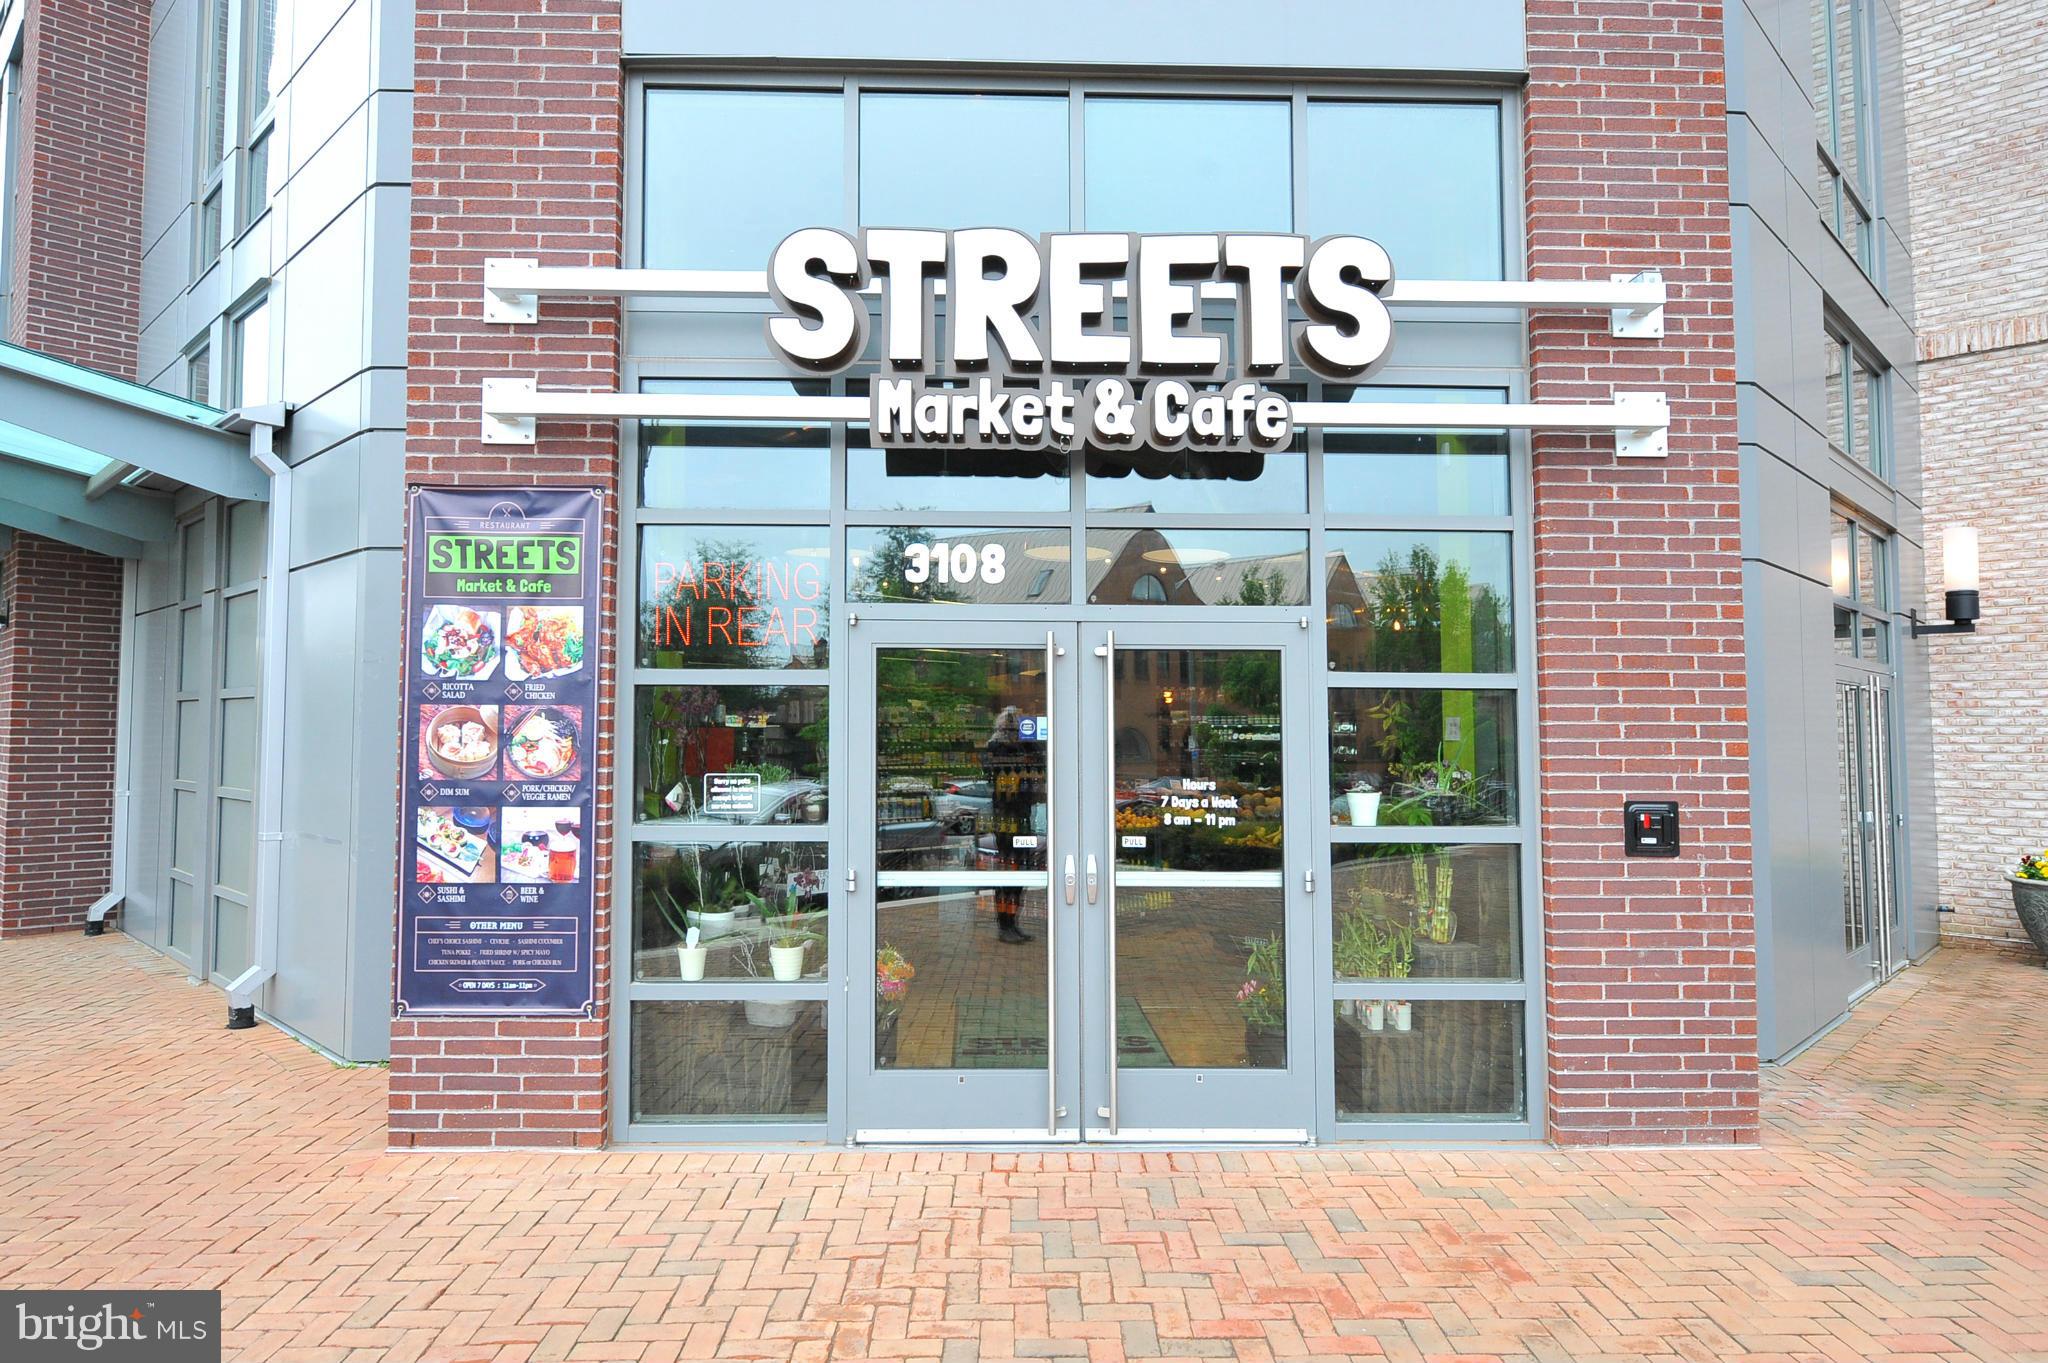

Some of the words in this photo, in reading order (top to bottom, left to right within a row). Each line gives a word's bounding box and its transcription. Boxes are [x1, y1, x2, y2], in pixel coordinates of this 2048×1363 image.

[769, 229, 1395, 369] STREETS
[878, 376, 1075, 446] Market
[1095, 378, 1136, 440] &
[1155, 378, 1289, 446] Cafe
[479, 522, 531, 530] RESTAURANT
[432, 539, 576, 570] STREETS
[904, 543, 1006, 584] 3108
[655, 561, 821, 600] PARKING
[456, 579, 502, 593] Market
[506, 580, 516, 593] &
[519, 580, 552, 593] Cafe
[655, 606, 691, 645] IN
[708, 606, 819, 645] REAR
[442, 683, 474, 691] RICOTTA
[525, 683, 545, 691] FRIED
[442, 691, 466, 699] SALAD
[525, 691, 555, 699] CHICKEN
[522, 785, 576, 793] PORK/CHICKEN/
[1182, 778, 1216, 792] Hours
[440, 788, 454, 796] DIM
[456, 788, 469, 796] SUM
[522, 792, 546, 800] VEGGIE
[548, 792, 570, 800] RAMEN
[1161, 797, 1168, 808] 7
[1171, 796, 1198, 811] Days
[1201, 799, 1209, 808] a
[1211, 796, 1238, 809] Week
[1164, 814, 1172, 826] 8
[1174, 817, 1192, 826] am
[1204, 814, 1216, 826] 11
[1219, 816, 1236, 828] pm
[438, 895, 466, 903] SASHIMI
[520, 895, 539, 903] WINE
[470, 922, 496, 930] OTHER
[500, 922, 522, 930] MENU
